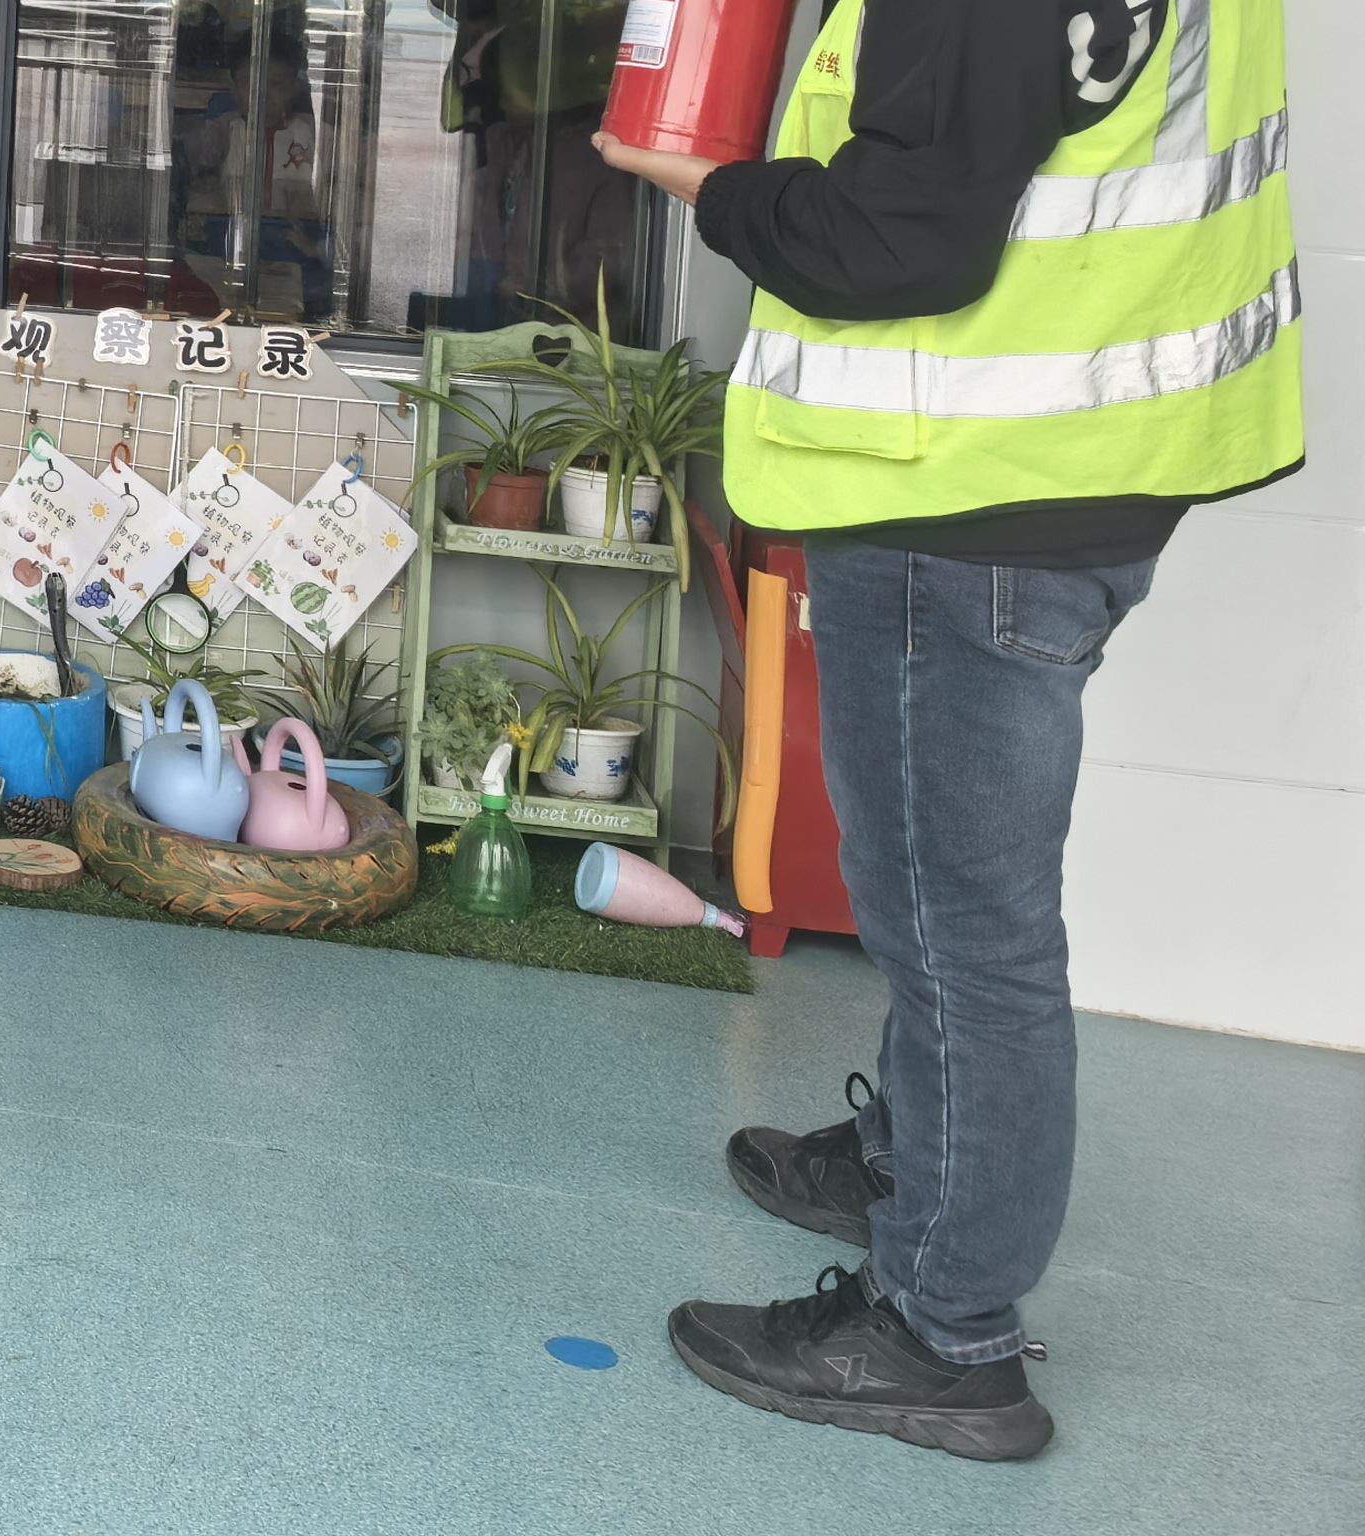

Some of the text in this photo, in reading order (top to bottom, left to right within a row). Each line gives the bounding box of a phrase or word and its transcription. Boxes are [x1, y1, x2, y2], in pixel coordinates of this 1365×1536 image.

[1, 315, 309, 377] 观察记录
[30, 489, 77, 529] 植物观察
[203, 504, 253, 545] 植物观察
[318, 512, 367, 557] 植物观察
[476, 531, 653, 565] Flowers & Garden
[448, 796, 631, 829] Ho Sweet Home
